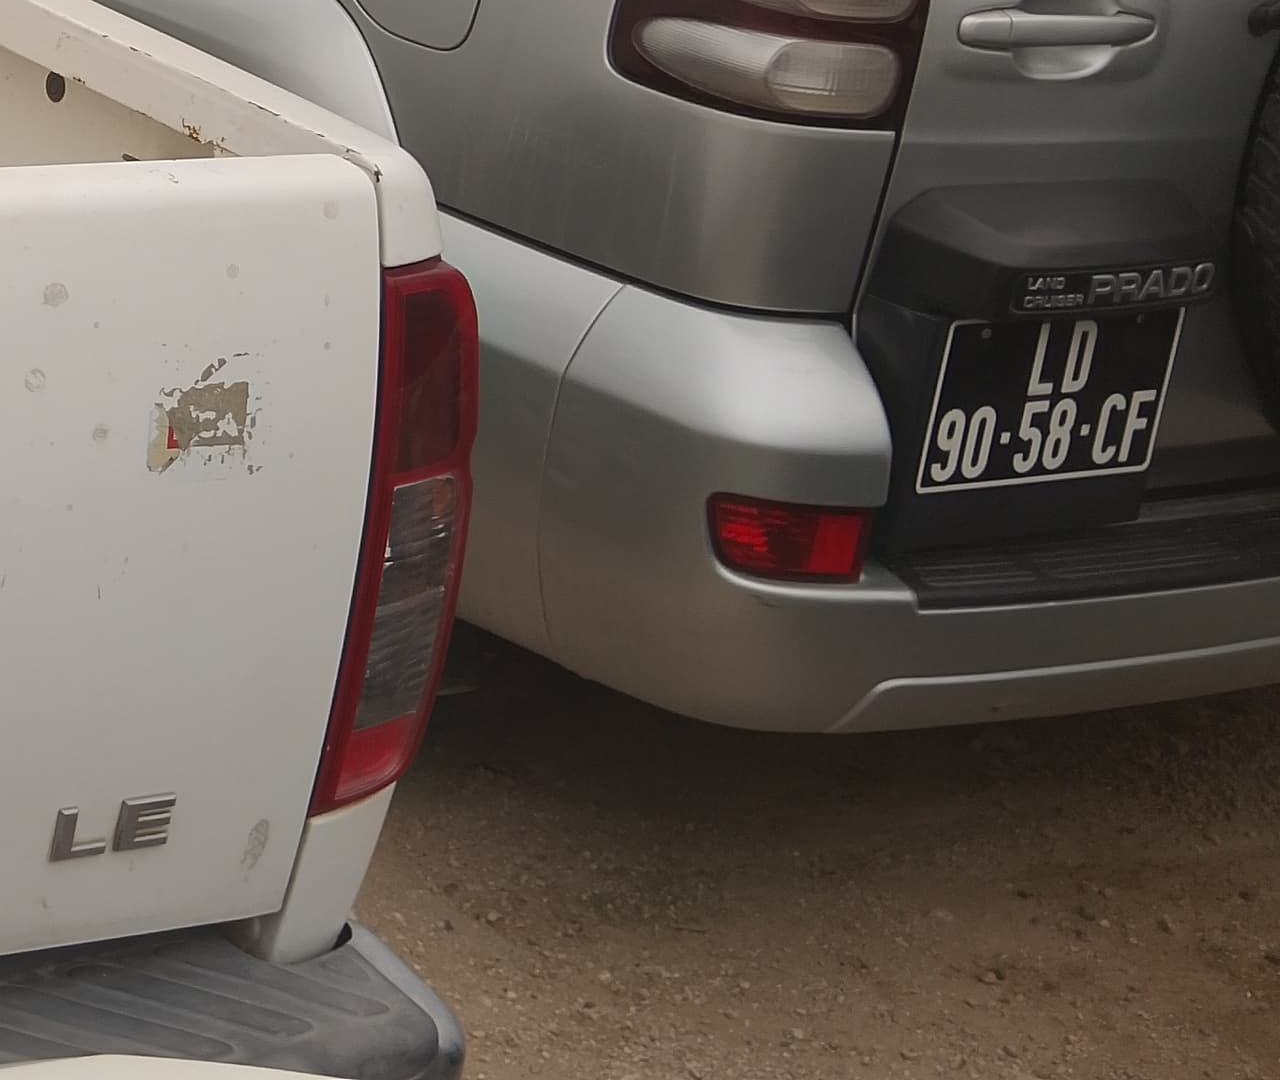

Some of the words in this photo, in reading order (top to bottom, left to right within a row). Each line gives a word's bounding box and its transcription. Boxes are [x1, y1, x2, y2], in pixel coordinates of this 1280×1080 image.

[1022, 293, 1085, 309] CRUISER
[1025, 276, 1067, 291] LAND
[1086, 261, 1216, 305] PRADO
[1026, 319, 1100, 398] LD
[48, 791, 178, 862] LE
